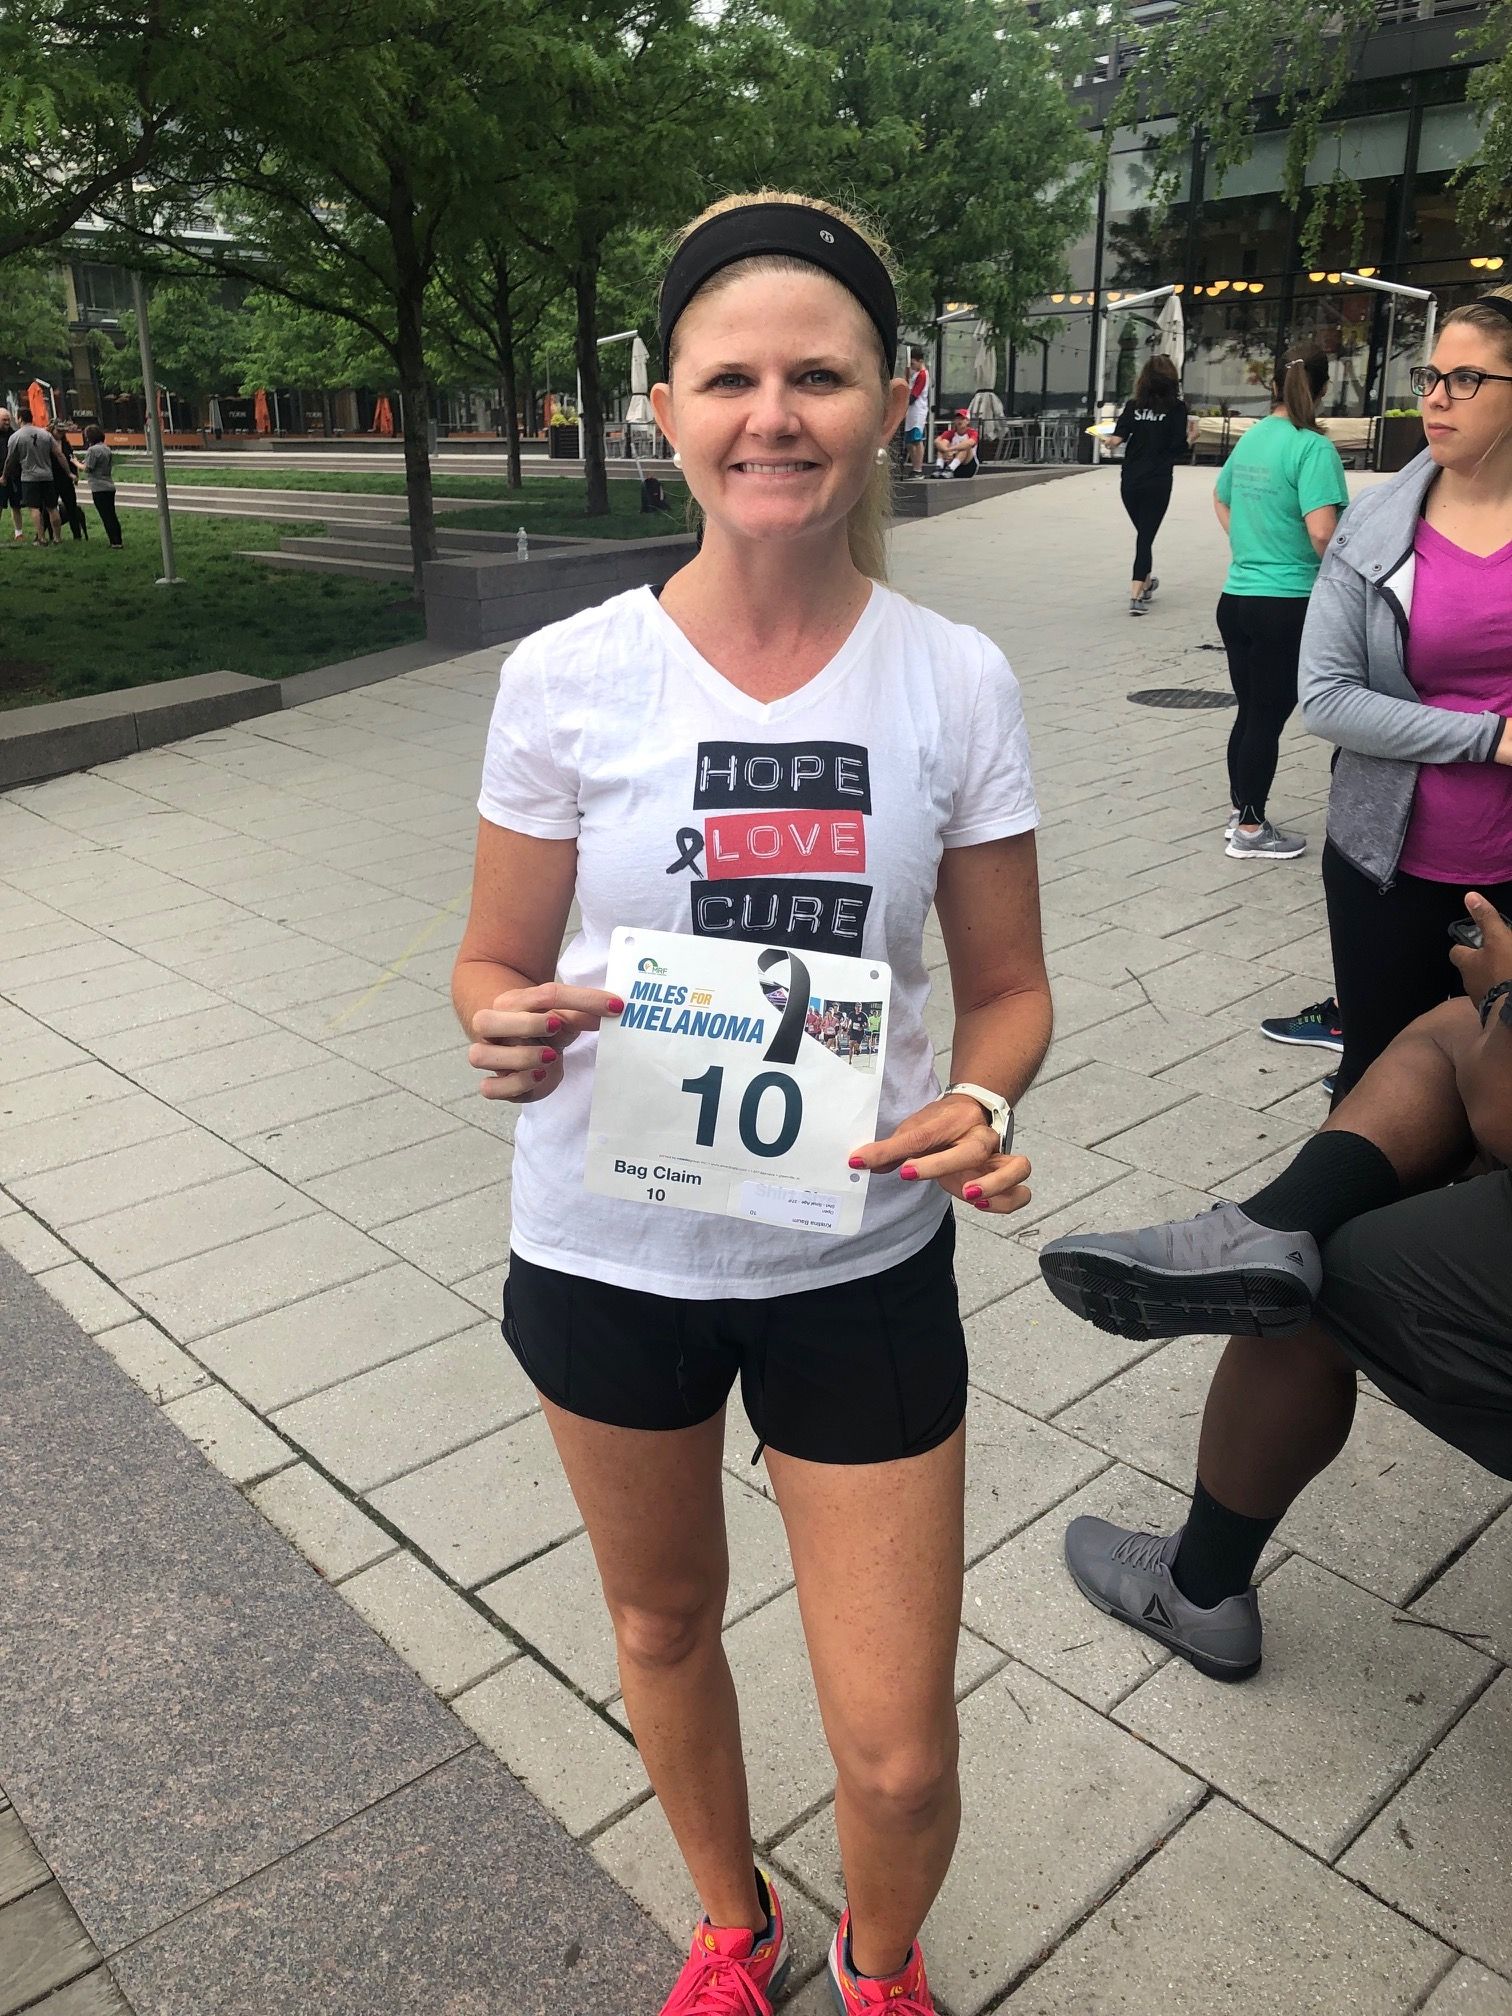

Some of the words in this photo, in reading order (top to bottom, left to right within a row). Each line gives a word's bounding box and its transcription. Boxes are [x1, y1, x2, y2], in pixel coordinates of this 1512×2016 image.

[698, 754, 864, 797] HOPE
[711, 822, 860, 863] LOVE
[696, 894, 864, 939] CURE
[652, 967, 668, 975] MRF
[630, 980, 688, 1005] MILES
[690, 991, 713, 1005] FOR
[620, 1003, 764, 1043] MELANOMA
[681, 1065, 803, 1158] 10
[614, 1159, 647, 1179] Bag
[653, 1165, 702, 1185] Claim
[646, 1187, 666, 1202] 10
[810, 1220, 832, 1228] Kristina
